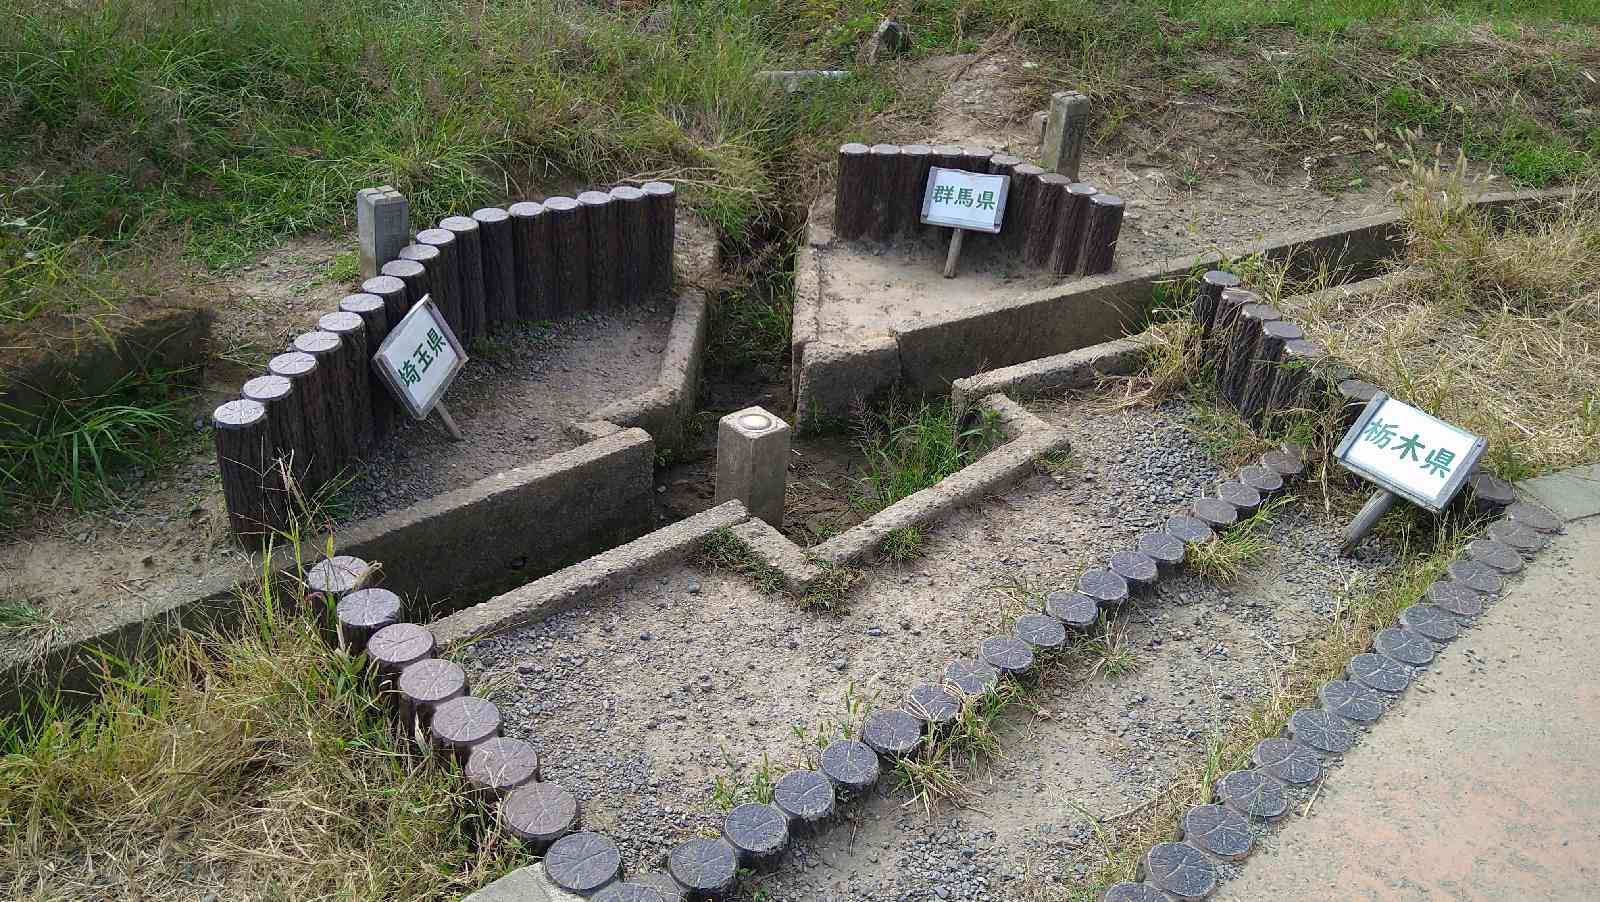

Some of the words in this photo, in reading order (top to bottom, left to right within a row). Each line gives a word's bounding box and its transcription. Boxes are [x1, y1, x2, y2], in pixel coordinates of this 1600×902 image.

[932, 185, 996, 211] 群馬県
[397, 328, 447, 387] 埼玉県
[1363, 417, 1457, 479] 栃木県
